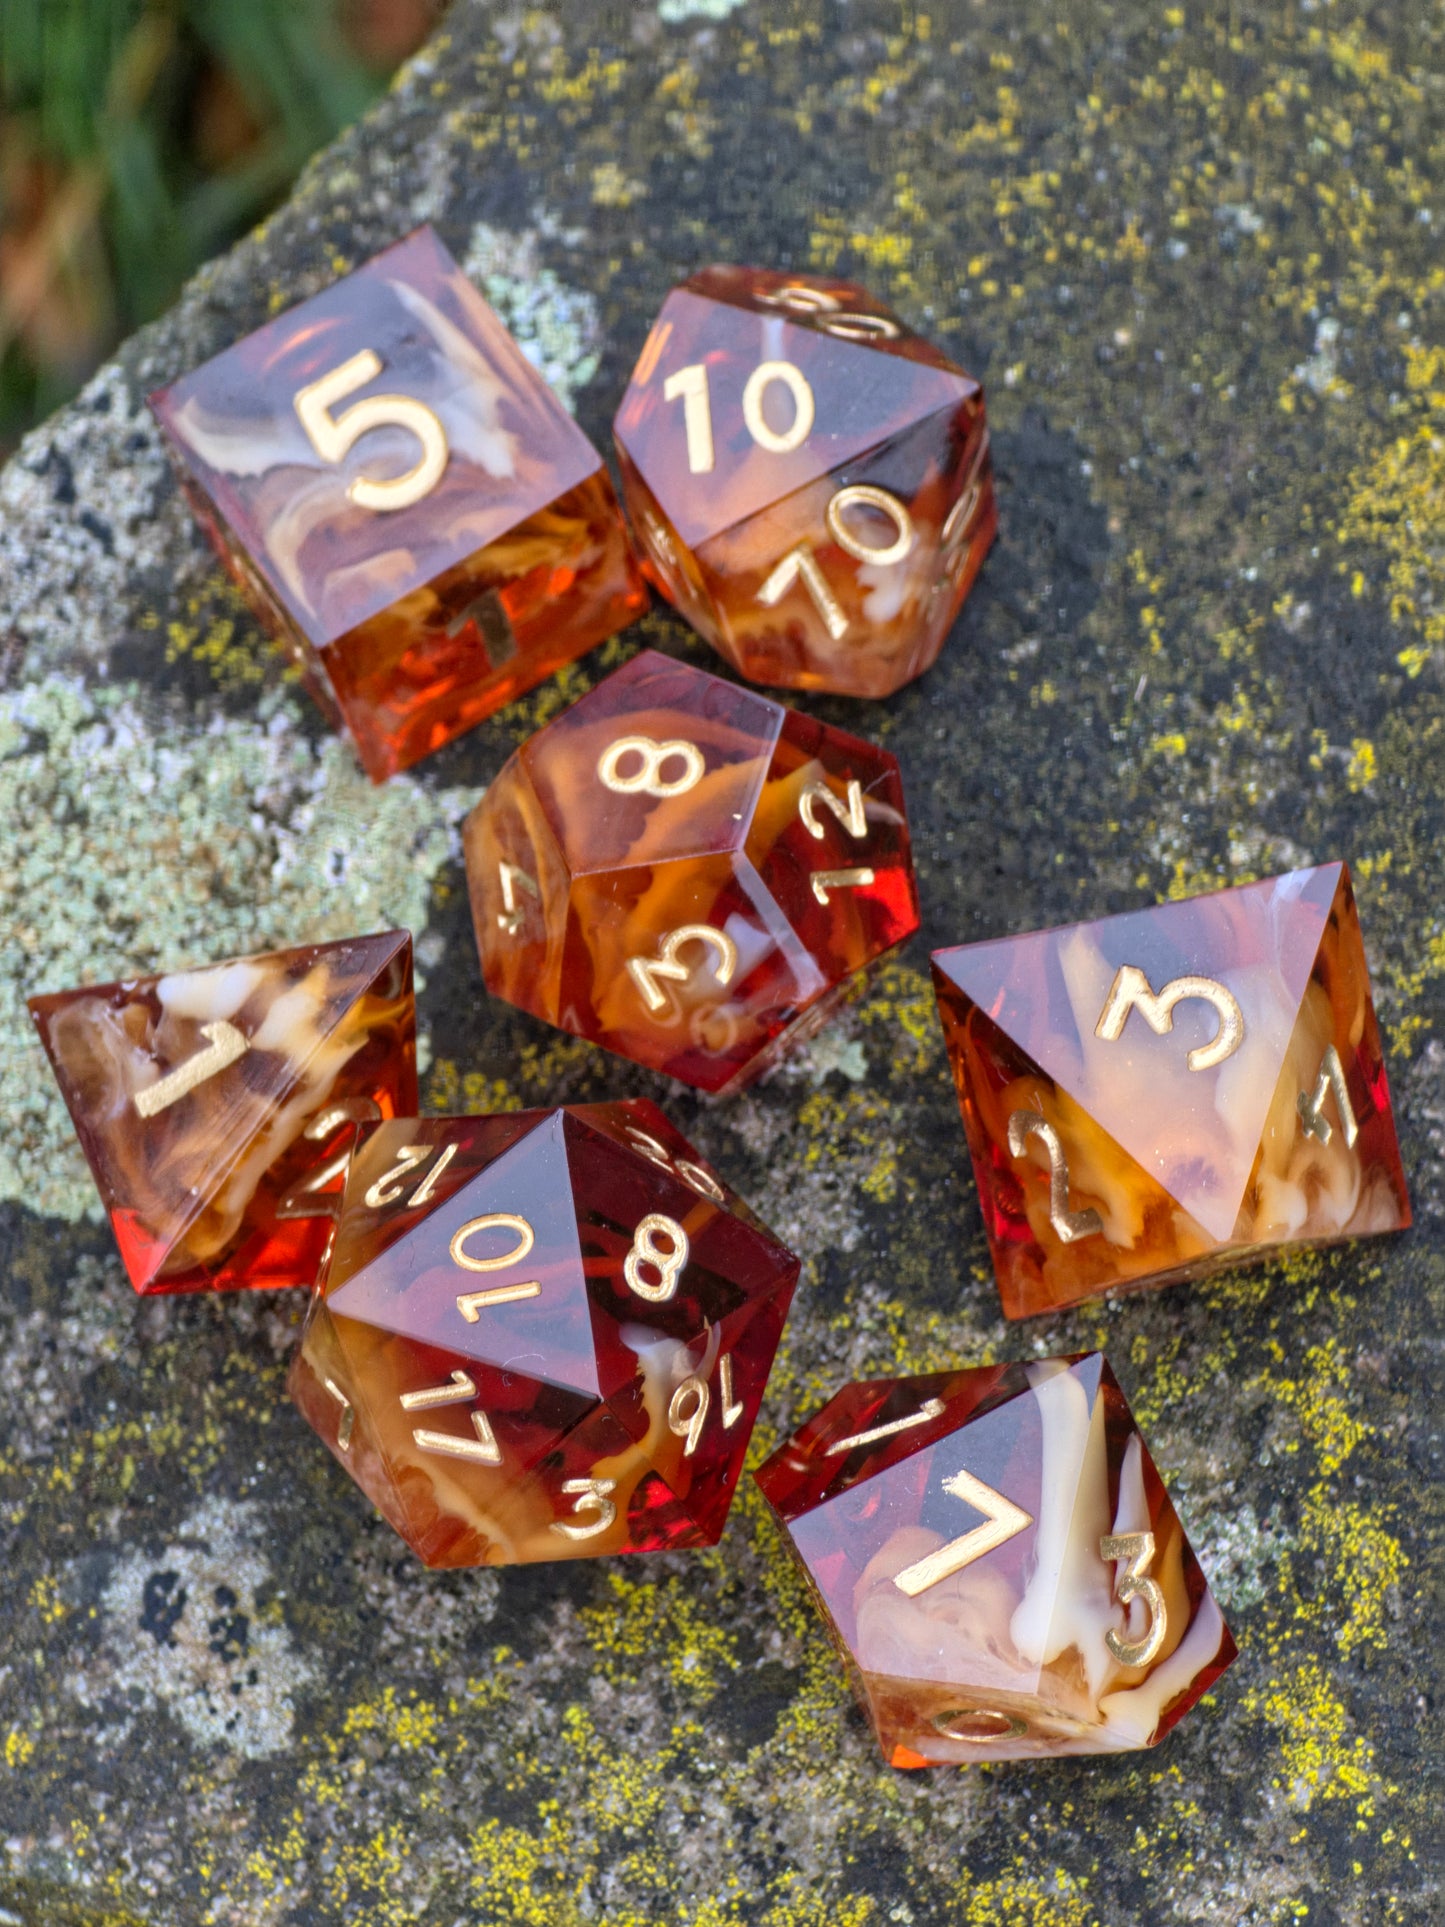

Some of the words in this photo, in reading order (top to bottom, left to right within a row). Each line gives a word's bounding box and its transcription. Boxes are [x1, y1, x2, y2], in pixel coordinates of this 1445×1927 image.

[294, 349, 449, 512] 5
[663, 360, 815, 474] 10
[756, 485, 913, 640] 70
[598, 735, 705, 797] 8
[799, 779, 875, 905] 12
[625, 924, 738, 1011] 3
[1094, 964, 1245, 1072] 3
[135, 1020, 251, 1119] 1
[1297, 1043, 1359, 1150] 4
[364, 1142, 459, 1208] 12
[1007, 1109, 1104, 1244] 2
[449, 1213, 542, 1325] 10
[624, 1213, 690, 1302] 8
[399, 1370, 502, 1467] 17
[549, 1478, 618, 1541] 3
[891, 1469, 1034, 1598] 7
[1099, 1531, 1168, 1668] 3
[931, 1708, 1029, 1742] 0
